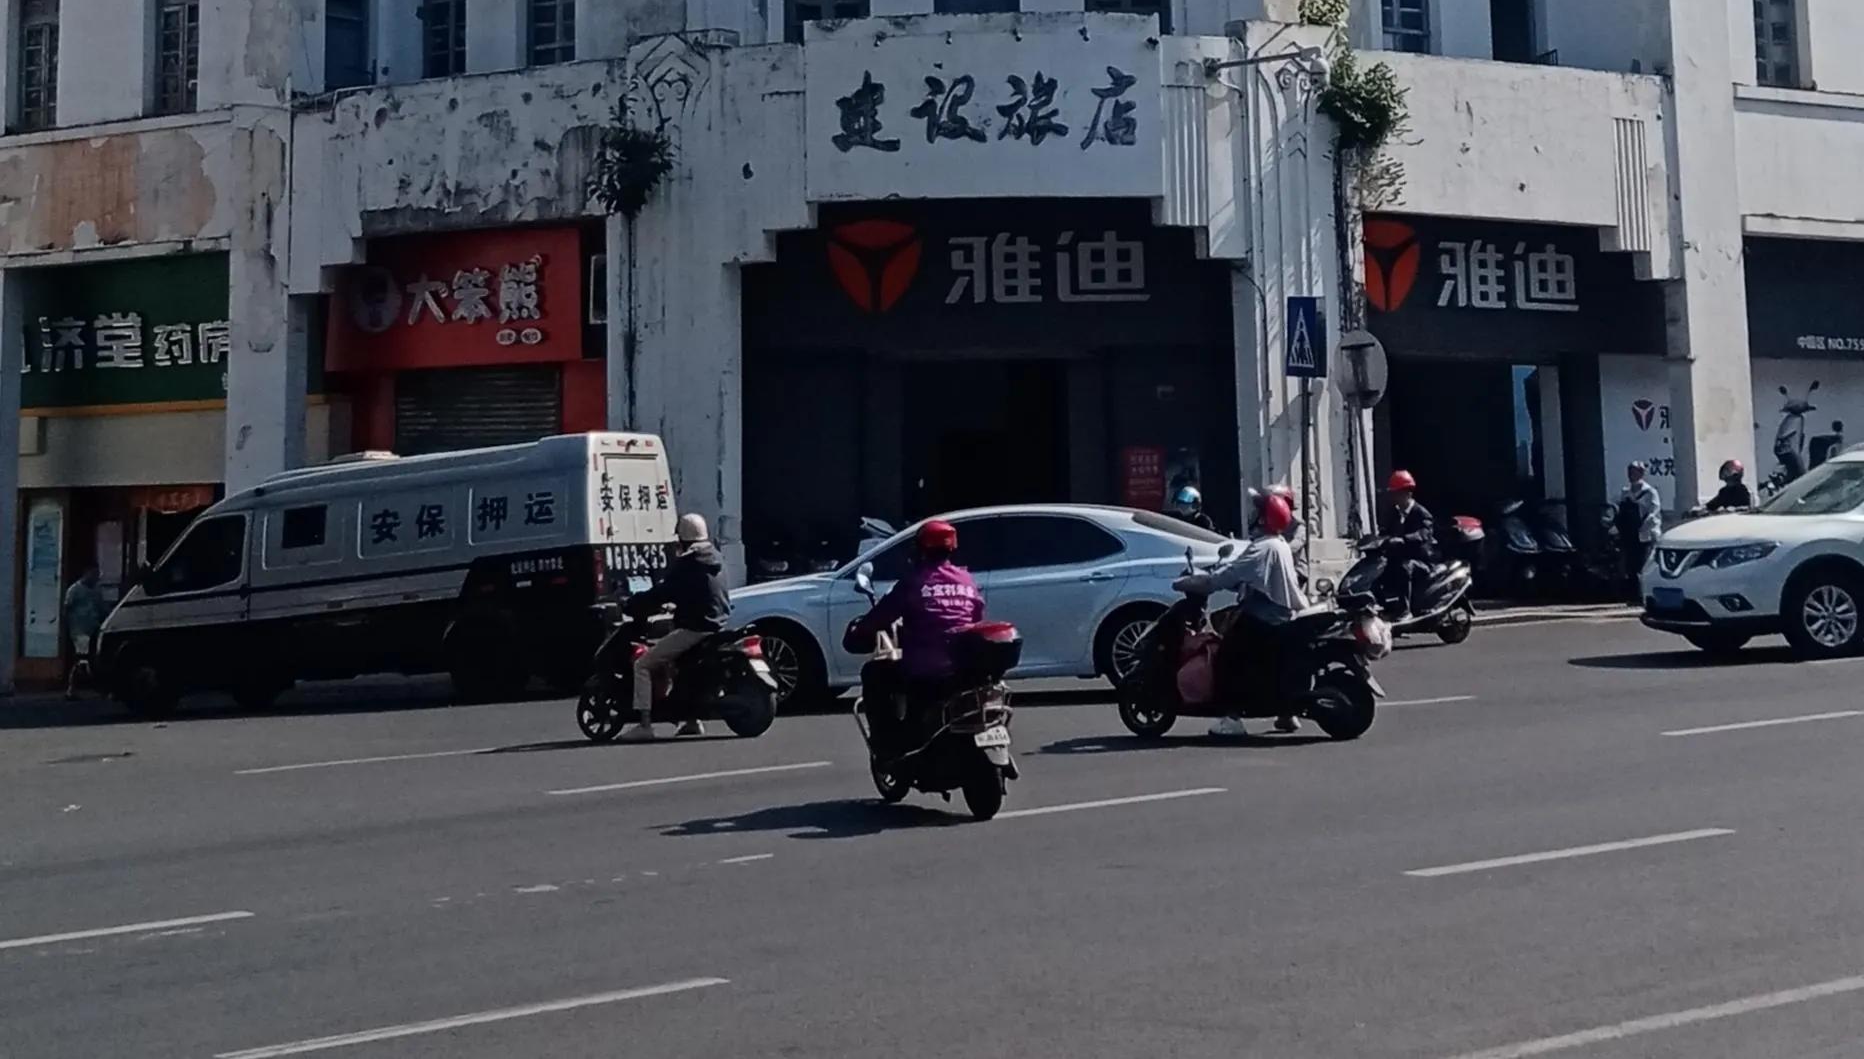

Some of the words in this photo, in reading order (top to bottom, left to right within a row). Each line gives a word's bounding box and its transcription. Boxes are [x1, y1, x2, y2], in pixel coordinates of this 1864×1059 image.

[832, 67, 1137, 152] 建设旅店
[406, 254, 542, 325] 大笨熊
[945, 230, 1151, 304] 雅迪
[1437, 239, 1580, 312] 雅迪
[20, 311, 229, 373] 济堂药房
